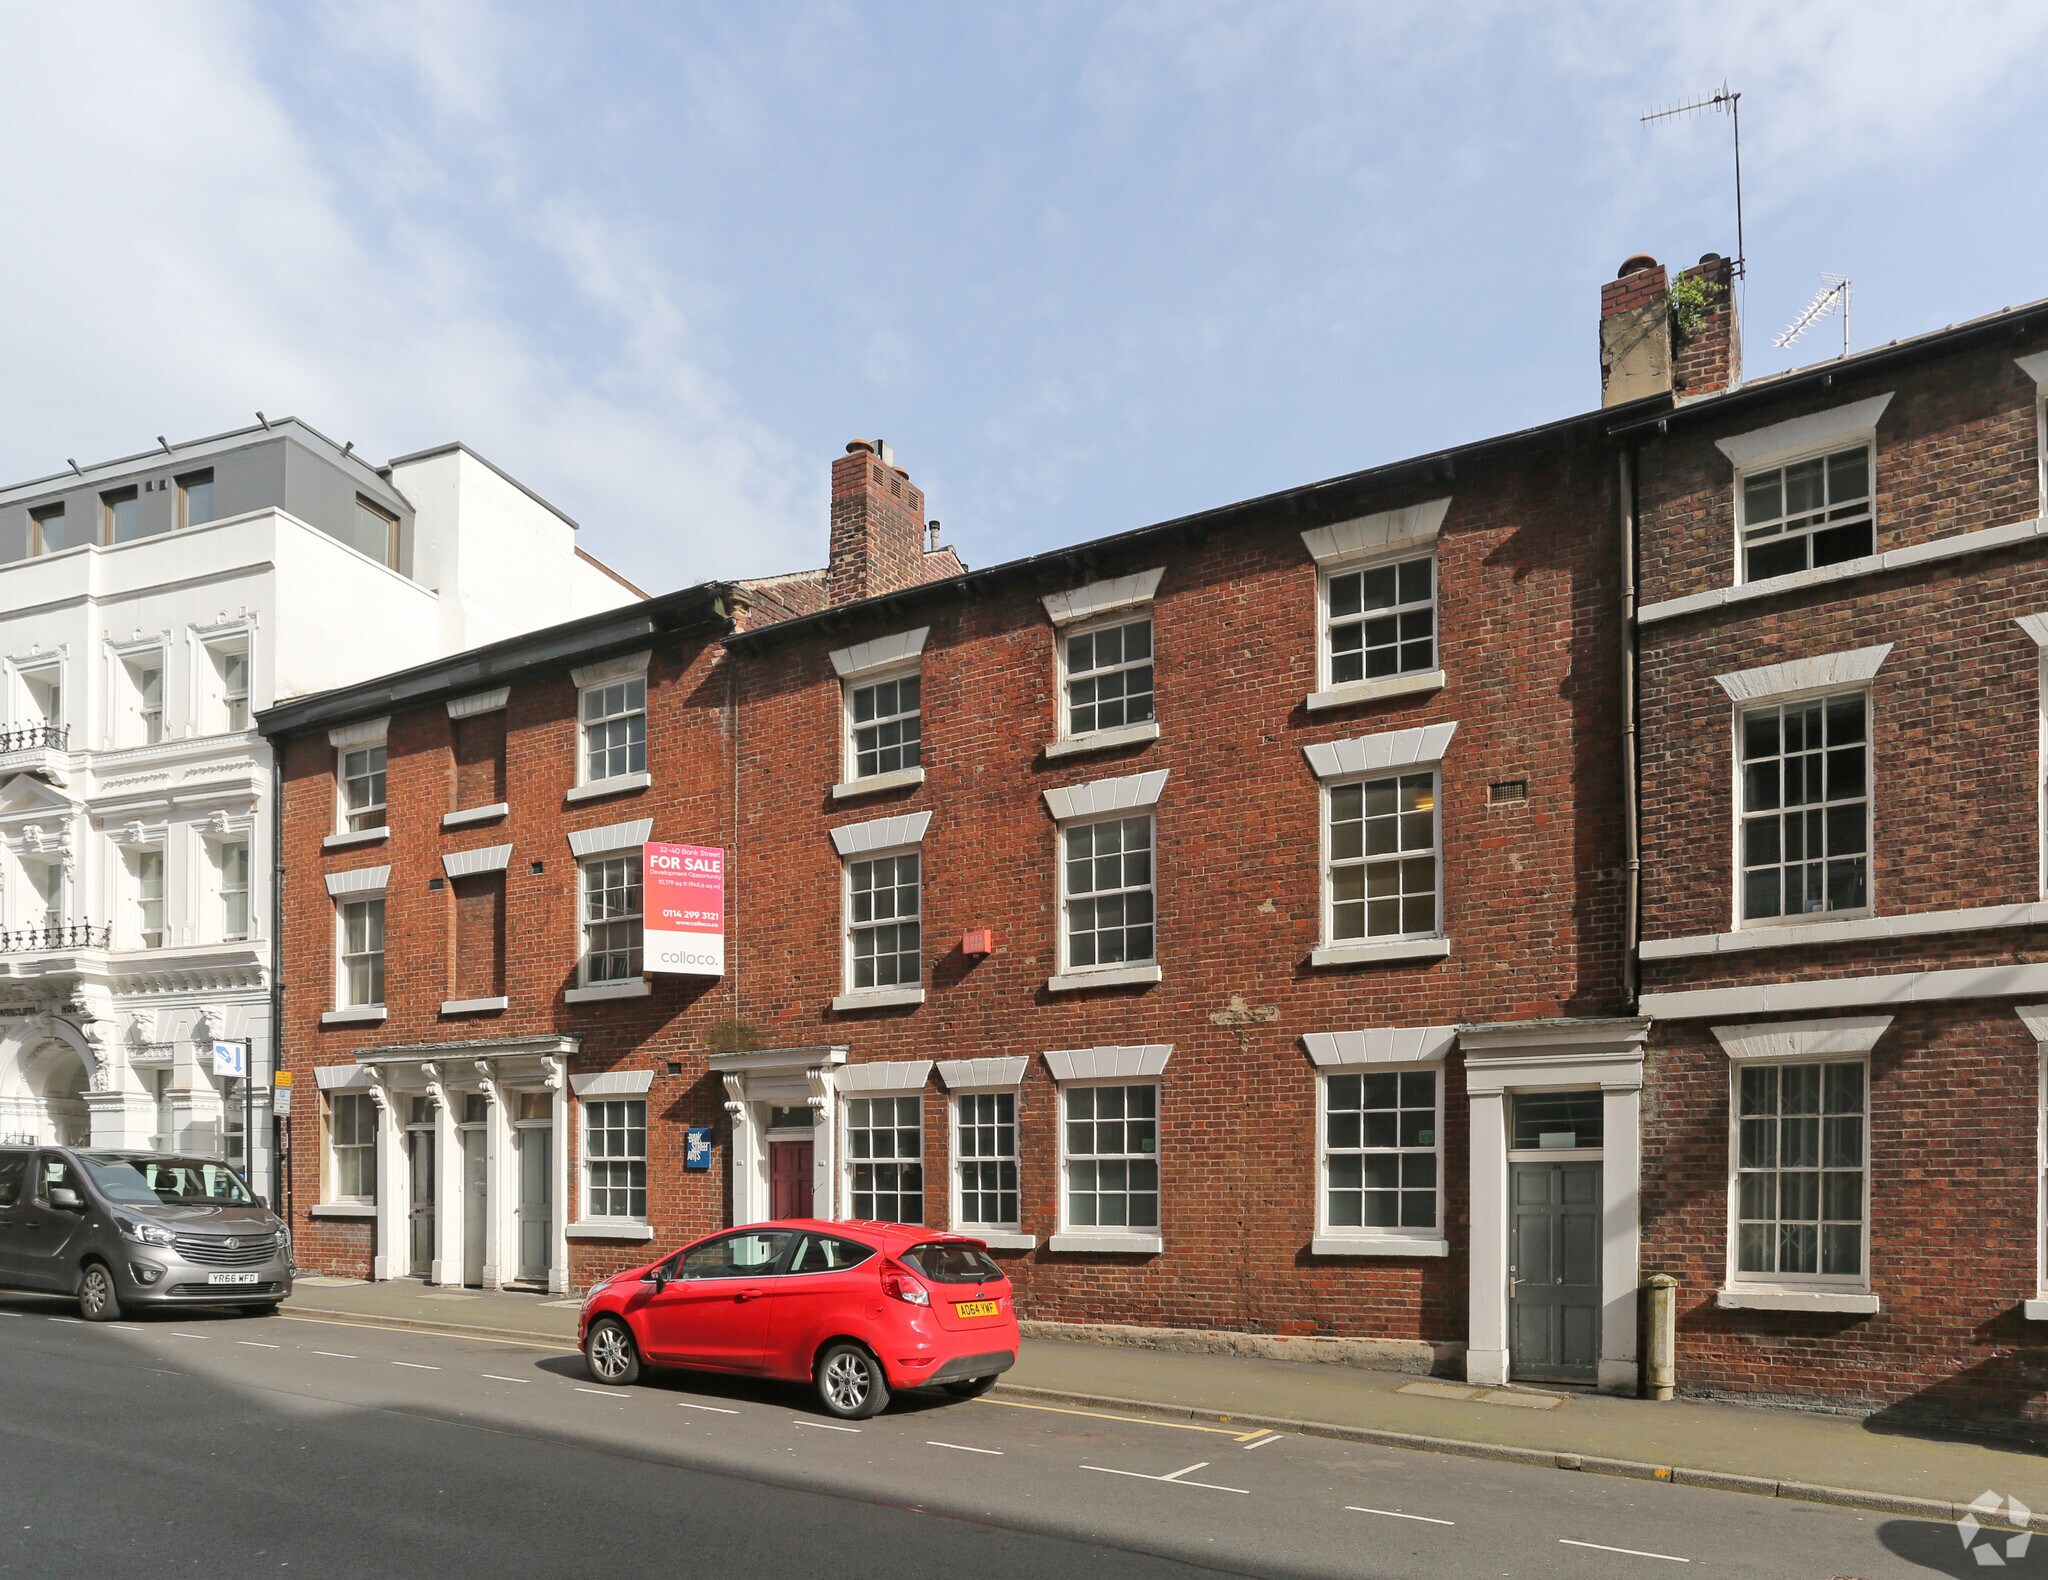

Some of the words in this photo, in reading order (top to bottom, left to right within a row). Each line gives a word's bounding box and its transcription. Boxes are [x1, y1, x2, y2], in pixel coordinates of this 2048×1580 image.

[659, 846, 681, 855] 32-40
[681, 848, 699, 856] Bank
[700, 849, 720, 858] Street
[650, 855, 681, 870] FOR
[684, 858, 721, 873] SALE
[649, 869, 687, 877] Development
[688, 871, 722, 880] Opportunity
[662, 909, 682, 918] 0114
[684, 910, 700, 919] 299
[701, 911, 719, 921] 3121
[675, 920, 719, 928] www.colloco.co
[213, 1274, 237, 1283] YR66
[239, 1274, 255, 1282] WFD
[979, 1302, 993, 1314] YWF
